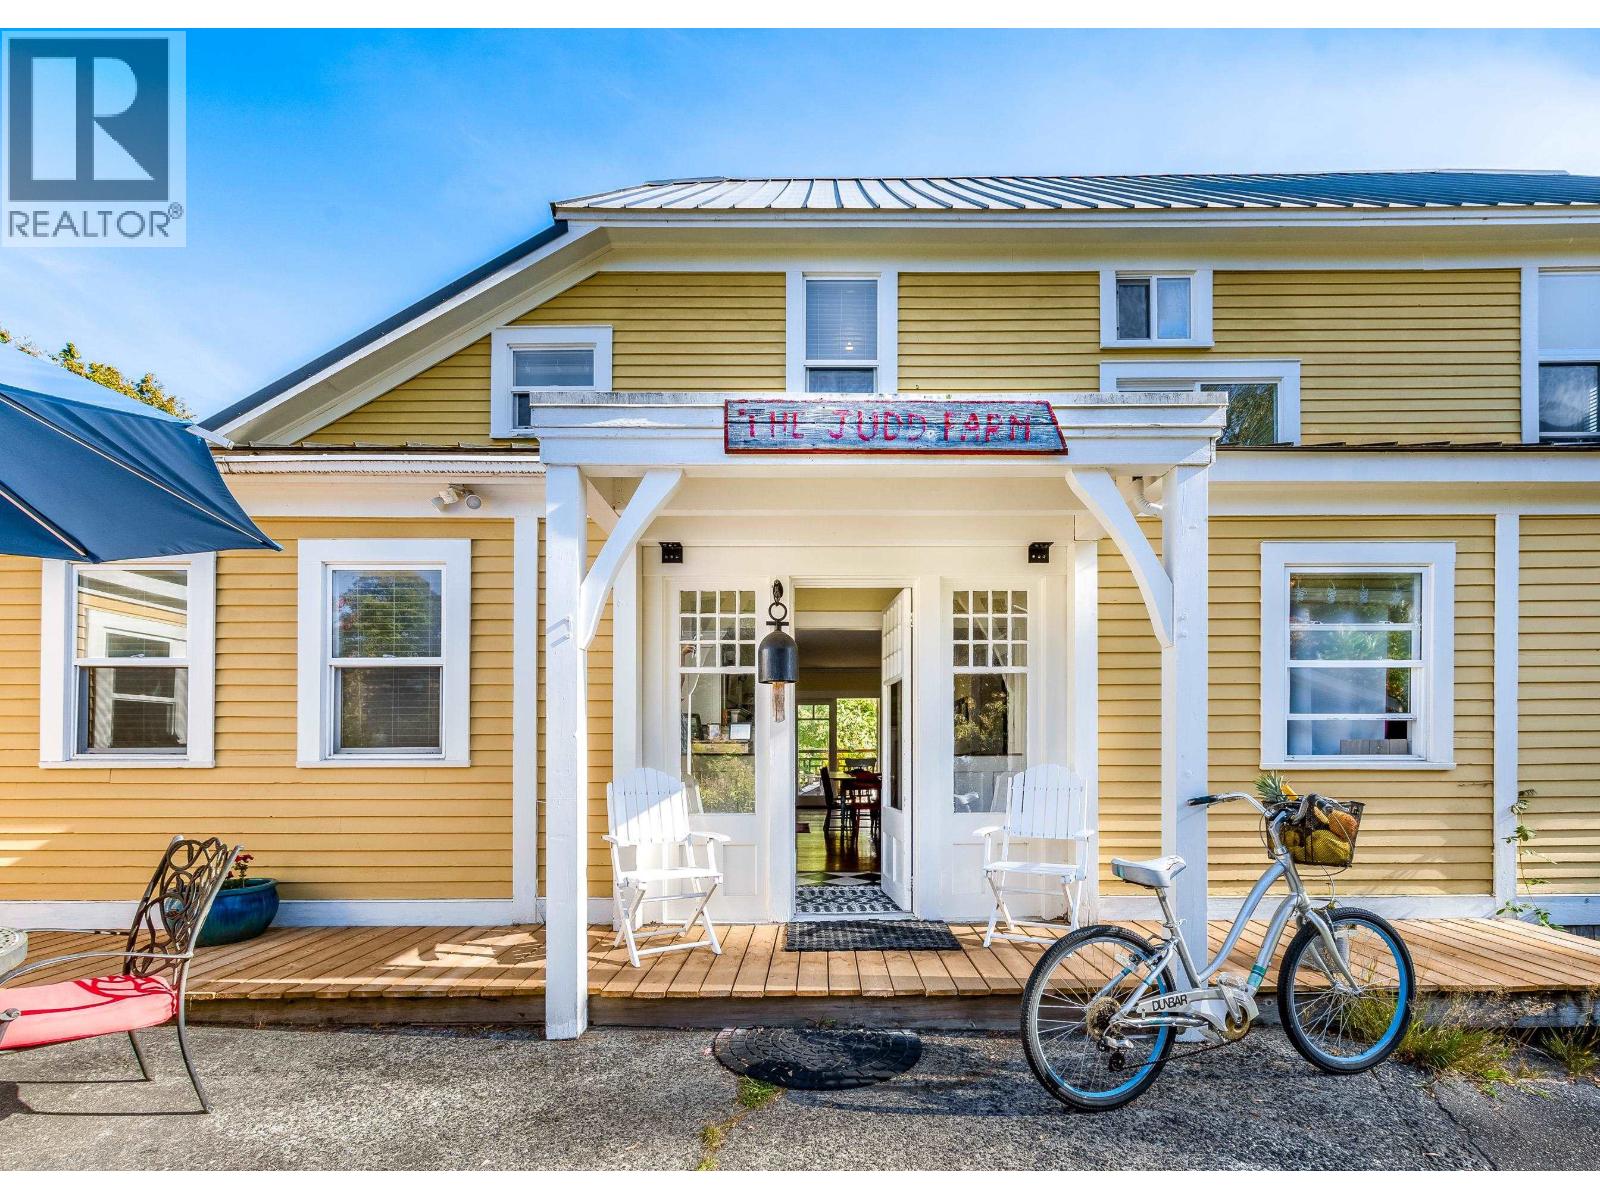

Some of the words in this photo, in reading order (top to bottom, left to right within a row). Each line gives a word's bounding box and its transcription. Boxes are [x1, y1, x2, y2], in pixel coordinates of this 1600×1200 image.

[738, 408, 805, 439] THE
[827, 408, 927, 442] JUDD
[943, 410, 1031, 442] FARM
[1152, 994, 1188, 1011] DUNBAR
